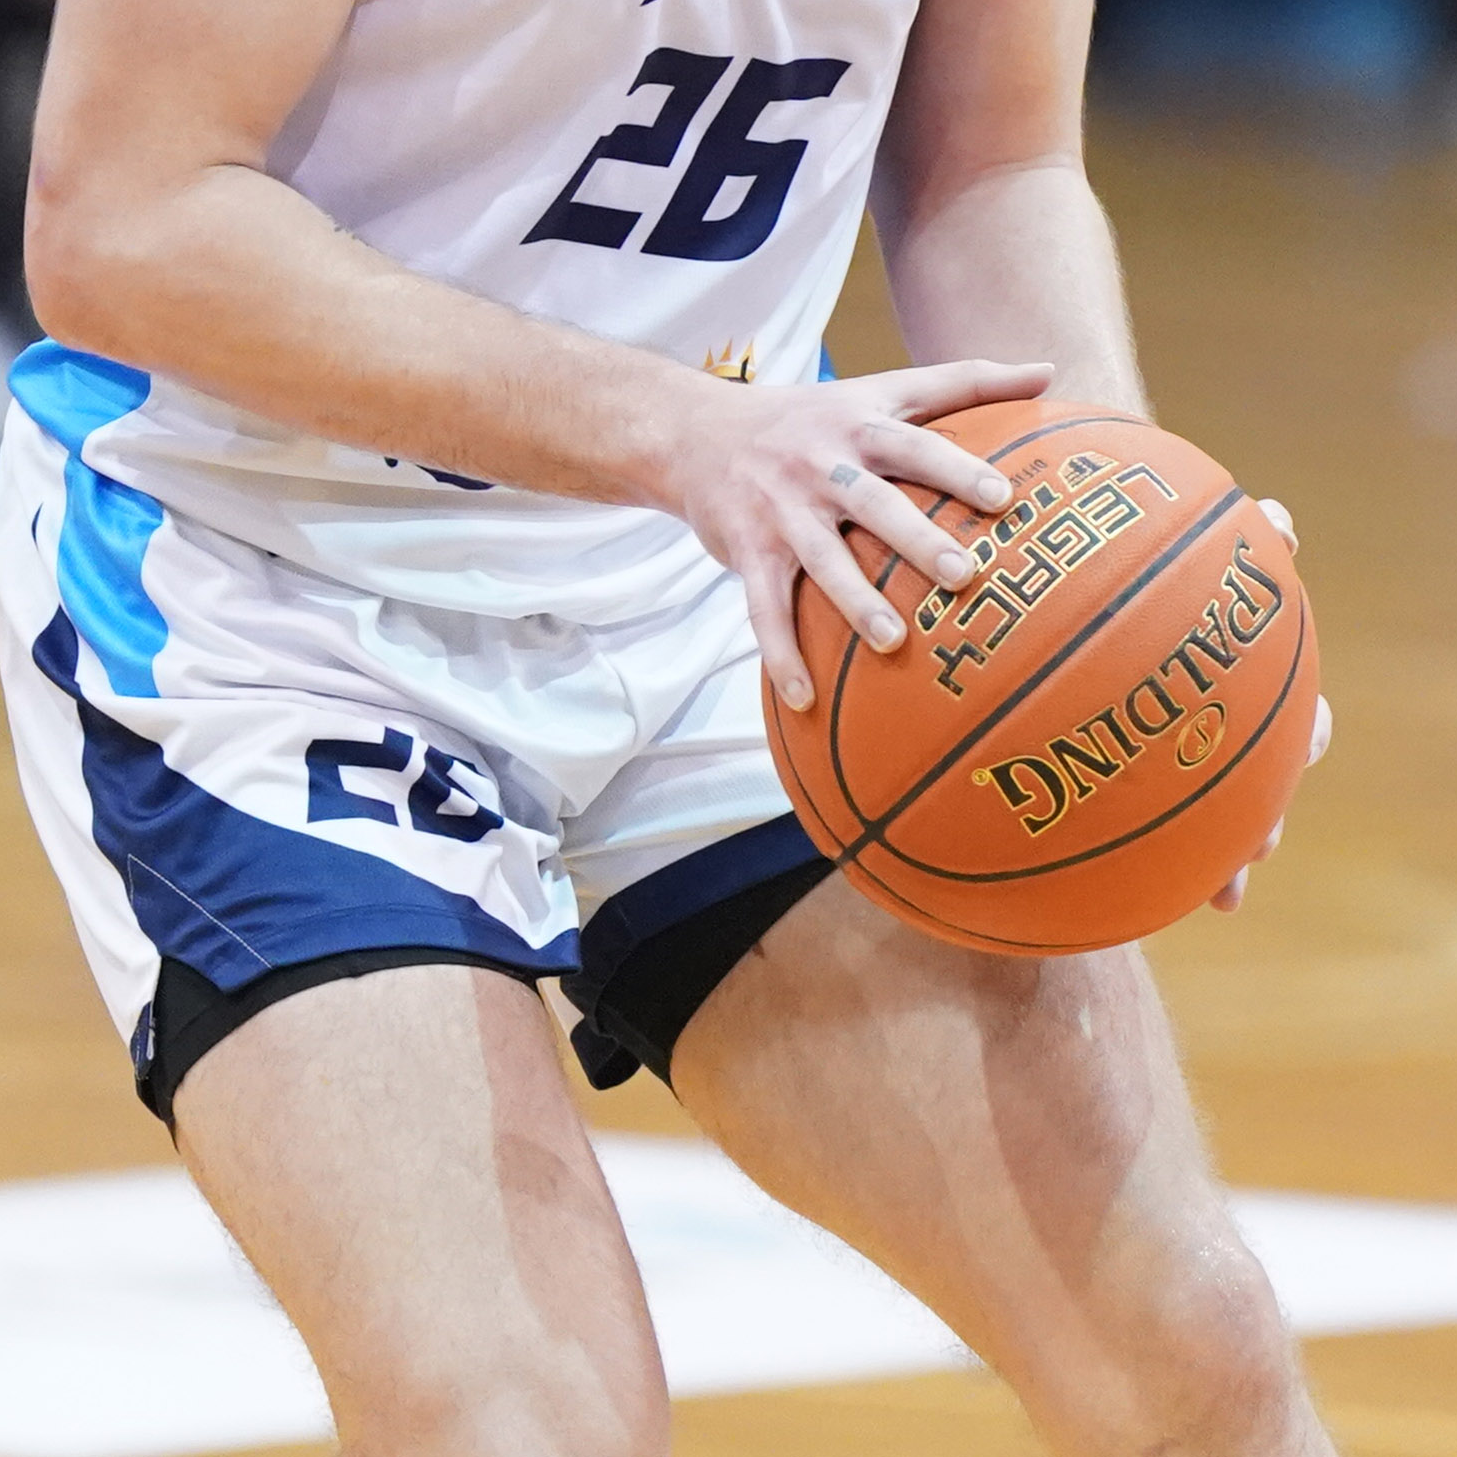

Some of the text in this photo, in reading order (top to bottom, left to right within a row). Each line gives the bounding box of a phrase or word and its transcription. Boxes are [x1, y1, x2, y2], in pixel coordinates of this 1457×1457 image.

[519, 46, 853, 262] 26
[929, 462, 1180, 700] LEGACY
[987, 531, 1282, 837] SPALDING
[304, 725, 505, 843] 26
